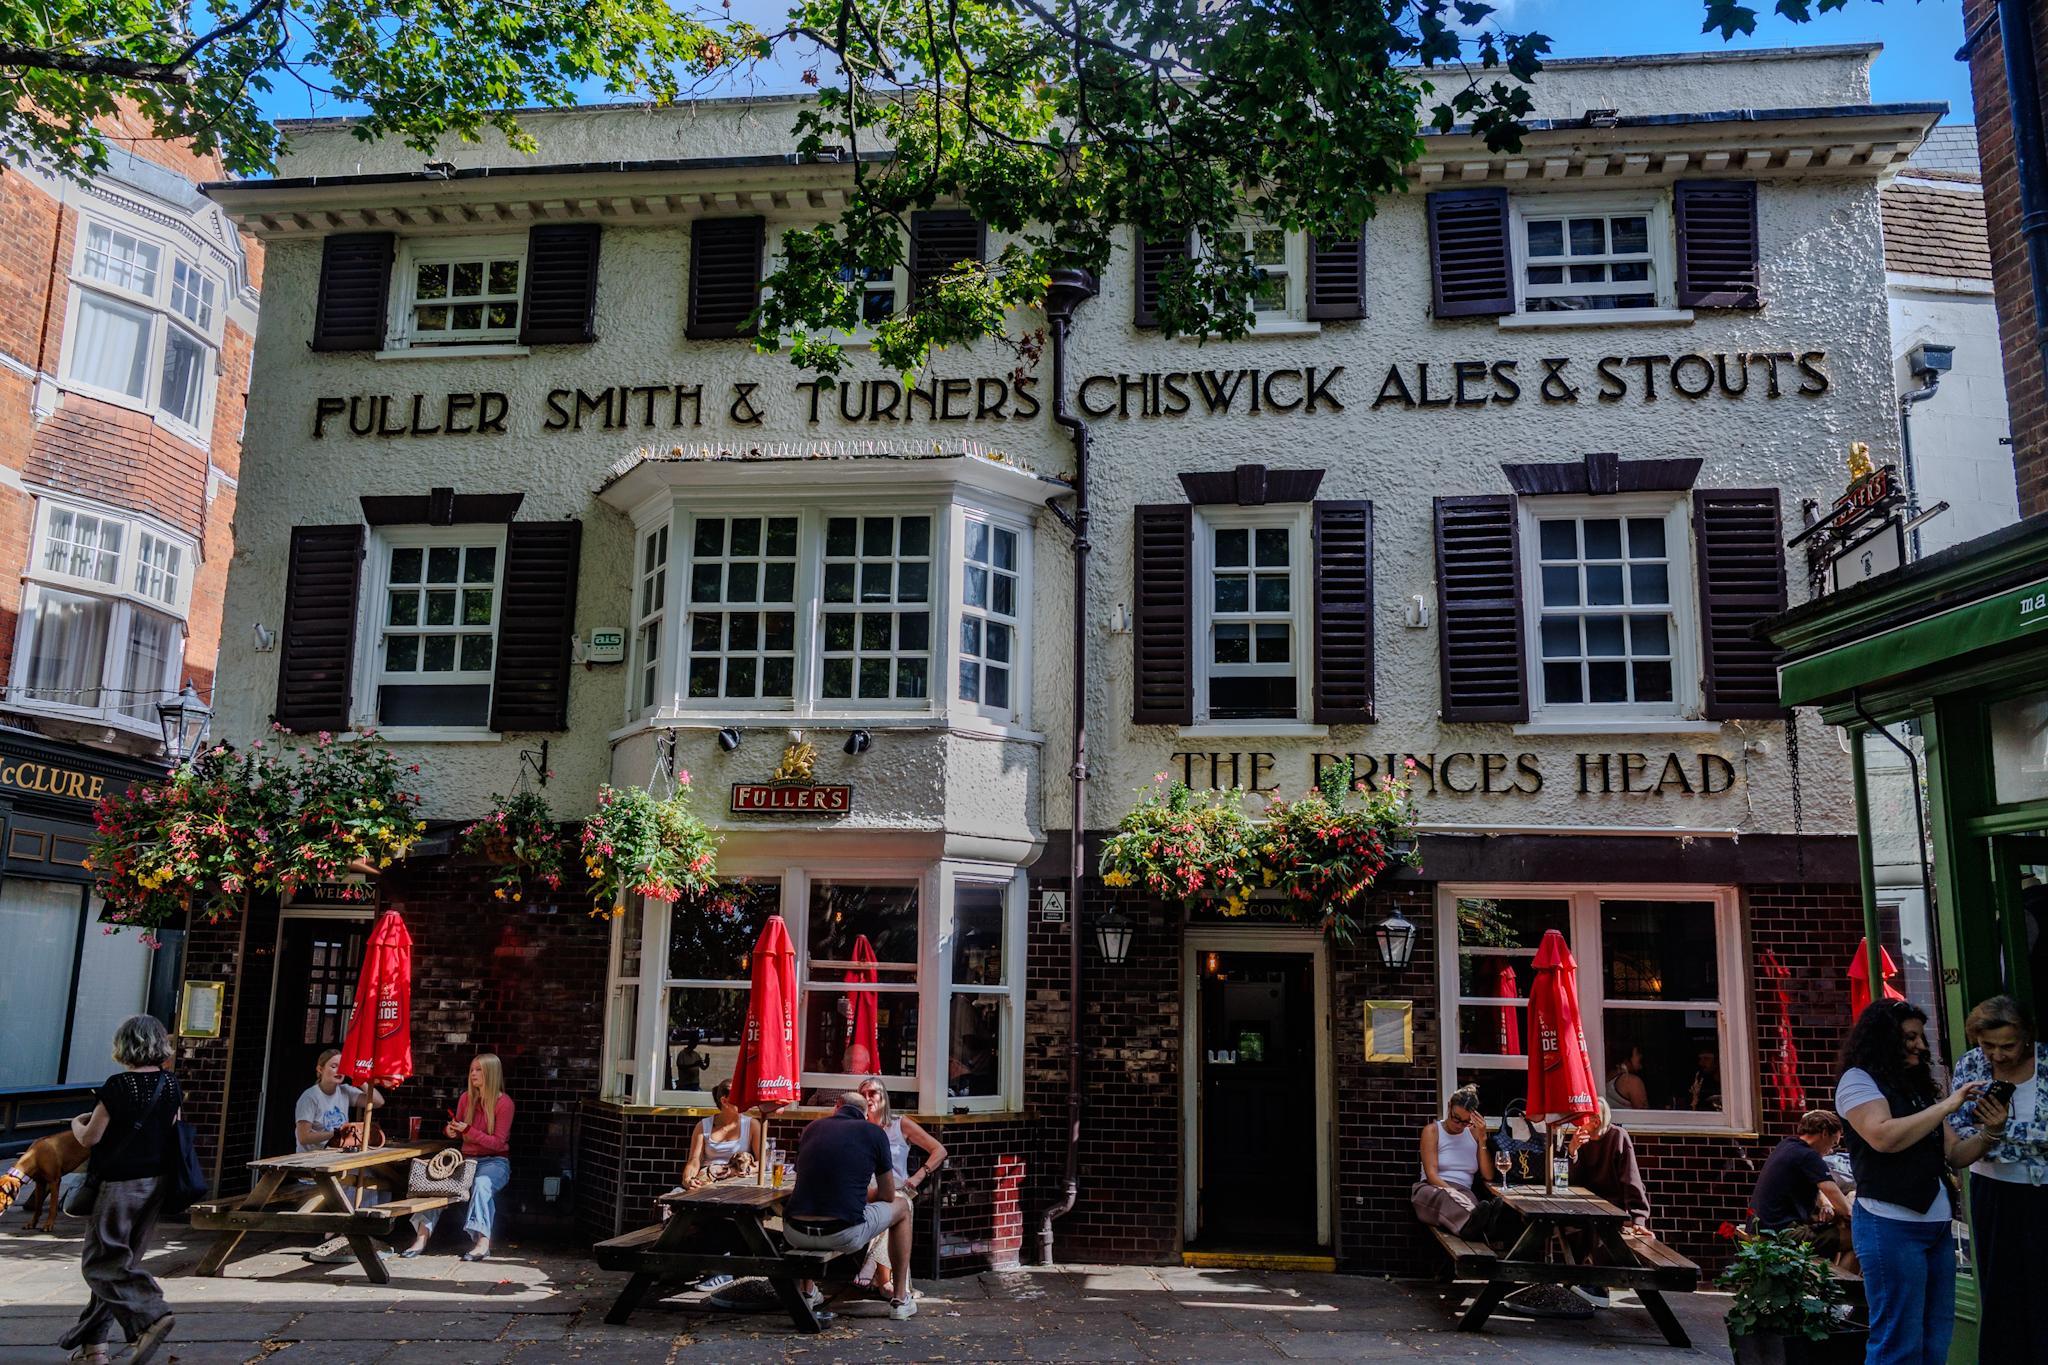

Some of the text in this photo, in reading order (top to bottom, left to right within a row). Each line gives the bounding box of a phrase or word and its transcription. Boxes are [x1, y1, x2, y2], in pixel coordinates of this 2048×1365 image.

[312, 351, 1830, 438] FULLER SMITH & TURNER'S CHISWICK ALES & STOUTS
[2020, 593, 2046, 615] ma
[1170, 751, 1737, 795] THE PRINCES HEAD
[738, 787, 843, 810] FULLER'S
